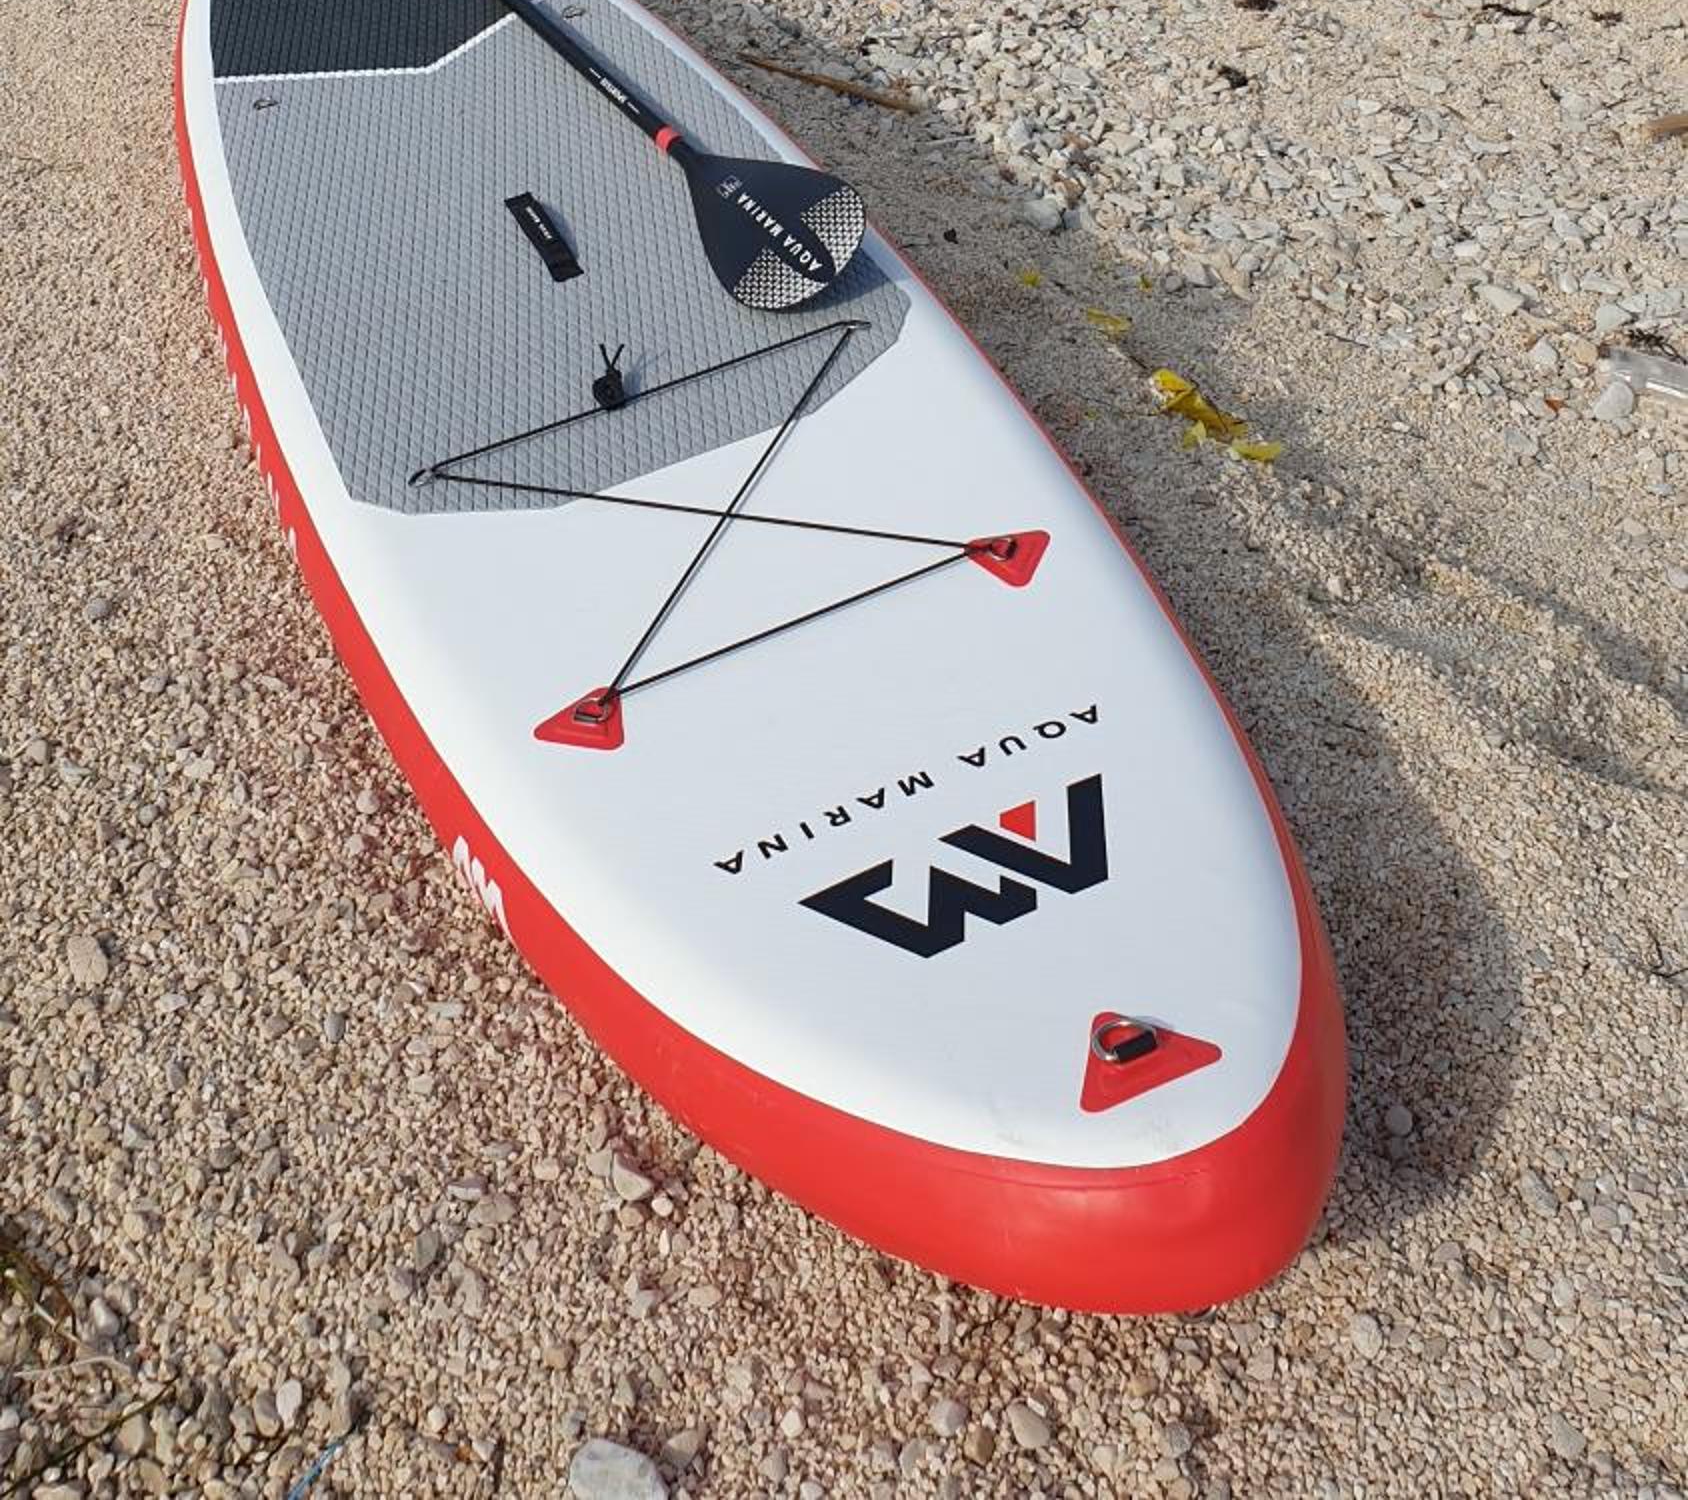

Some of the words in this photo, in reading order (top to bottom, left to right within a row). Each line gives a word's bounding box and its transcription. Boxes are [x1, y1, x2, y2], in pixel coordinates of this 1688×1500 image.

[737, 192, 784, 237] MARINA
[783, 234, 823, 271] AQUA
[957, 704, 1099, 767] AQUA
[713, 771, 935, 874] MARINA
